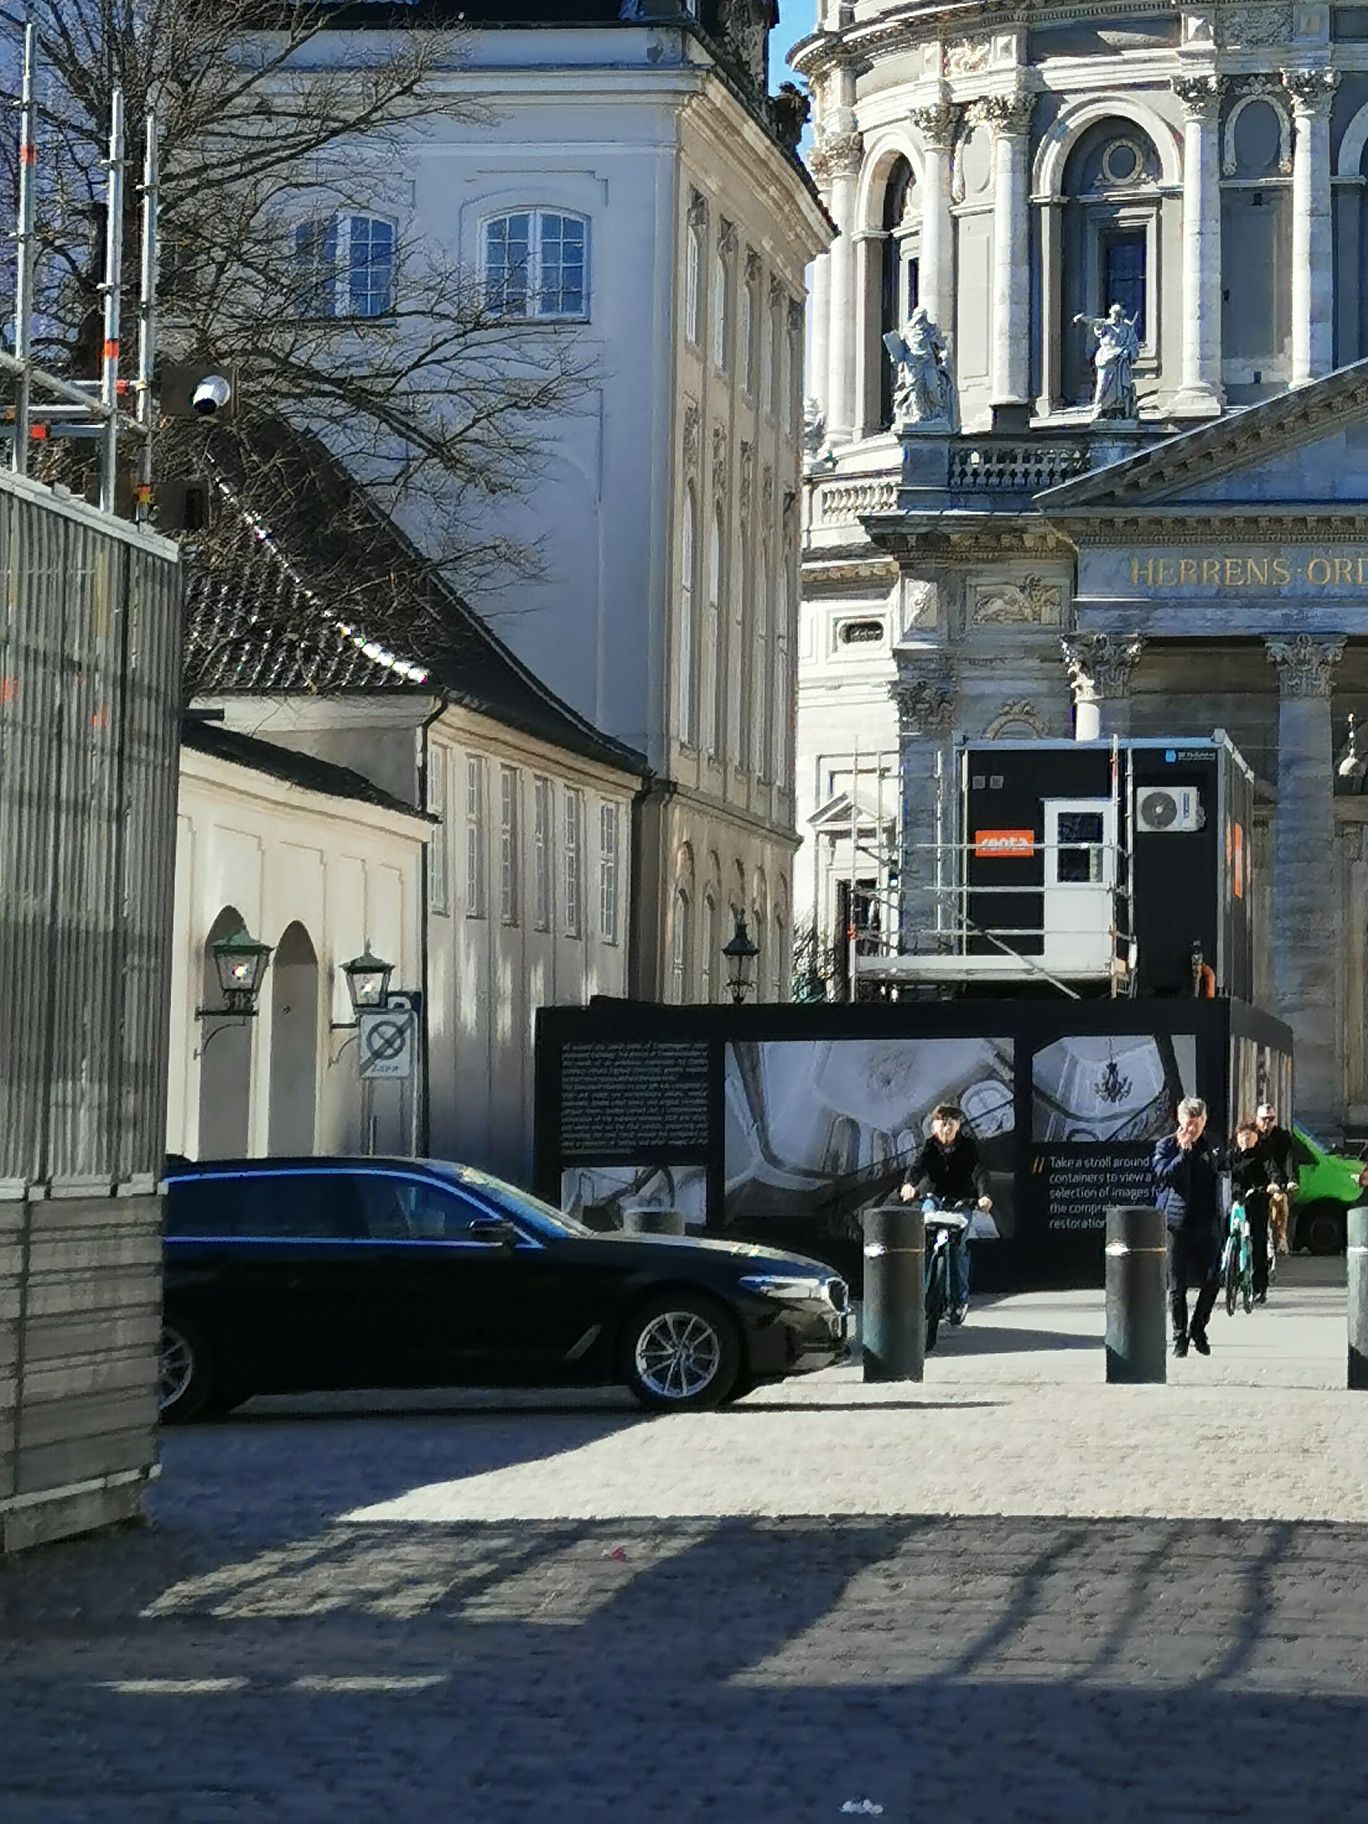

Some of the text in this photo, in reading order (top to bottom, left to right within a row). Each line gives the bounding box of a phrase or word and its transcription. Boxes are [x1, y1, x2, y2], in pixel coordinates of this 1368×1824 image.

[1130, 558, 1291, 587] HERRENS
[1049, 1156, 1074, 1169] Take
[1083, 1156, 1111, 1169] stroll
[1113, 1156, 1150, 1169] around
[1049, 1172, 1104, 1184] containers
[1106, 1172, 1118, 1184] to
[1119, 1172, 1144, 1184] view
[1049, 1187, 1097, 1200] selection
[1099, 1186, 1111, 1198] of
[1112, 1186, 1149, 1200] images
